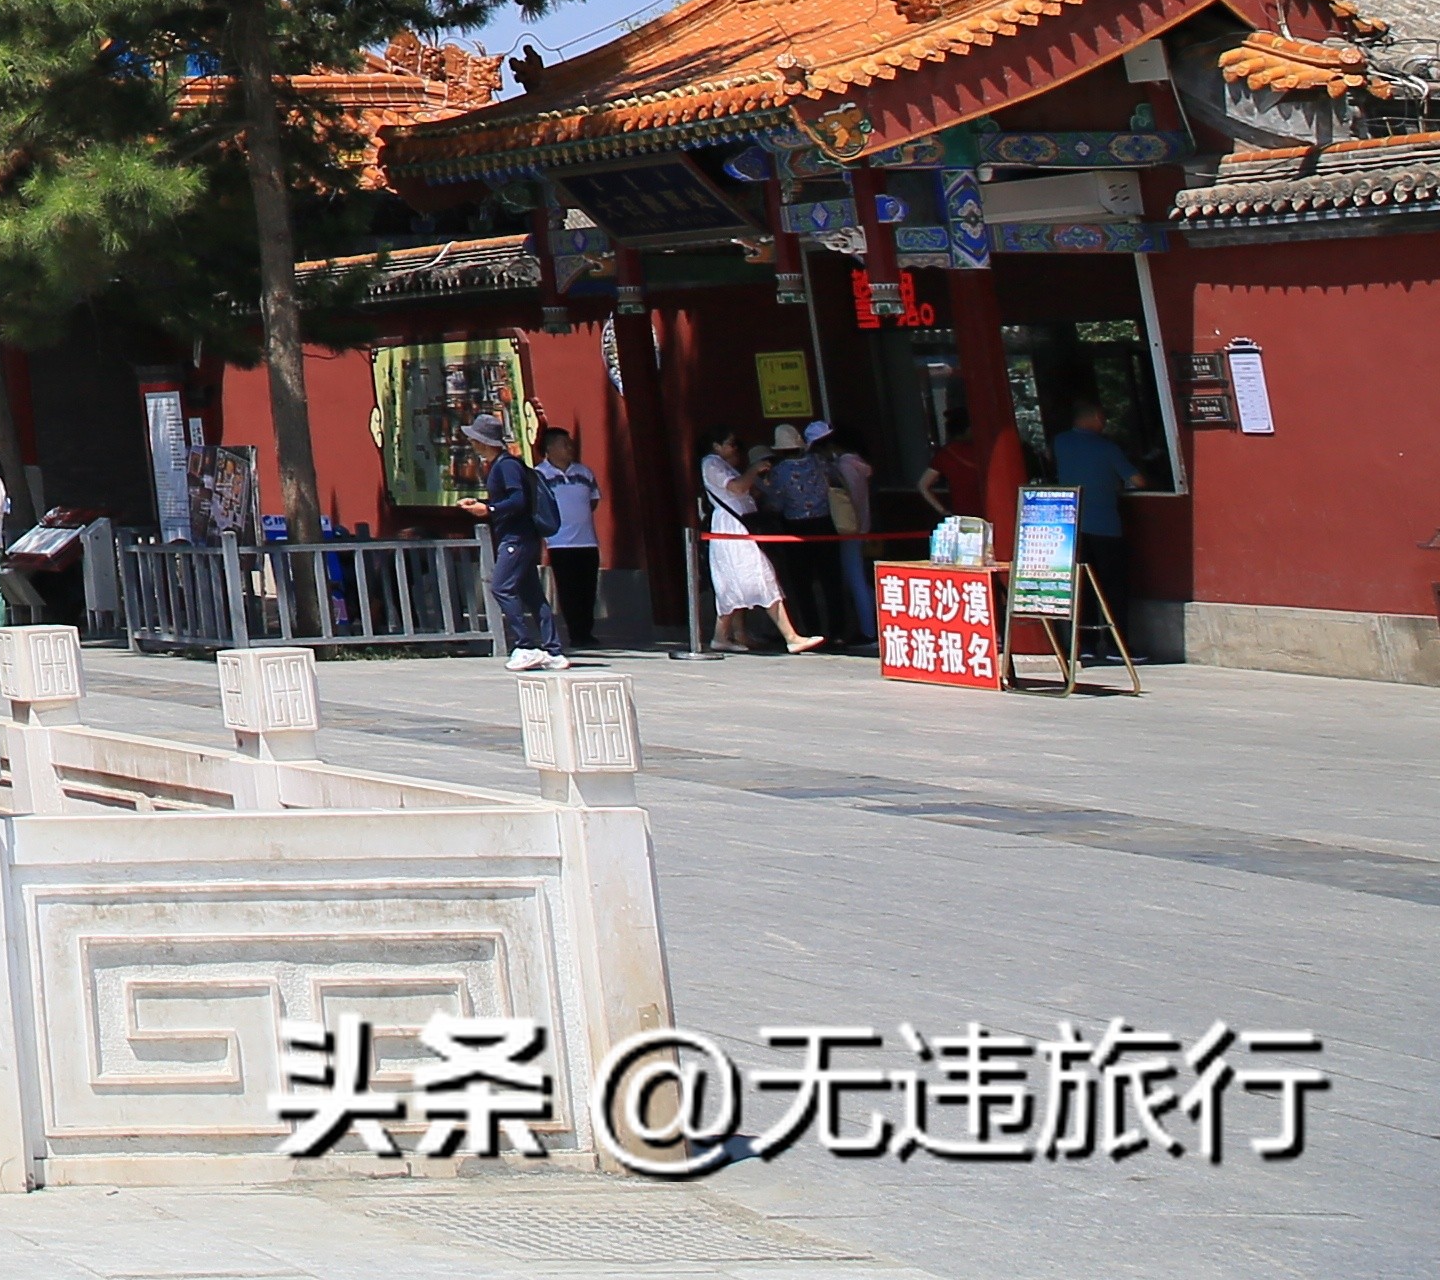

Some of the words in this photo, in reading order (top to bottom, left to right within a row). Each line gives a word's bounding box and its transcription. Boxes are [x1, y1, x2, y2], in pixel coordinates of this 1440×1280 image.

[880, 575, 990, 625] 草原沙漠
[883, 625, 993, 679] 旅游报名
